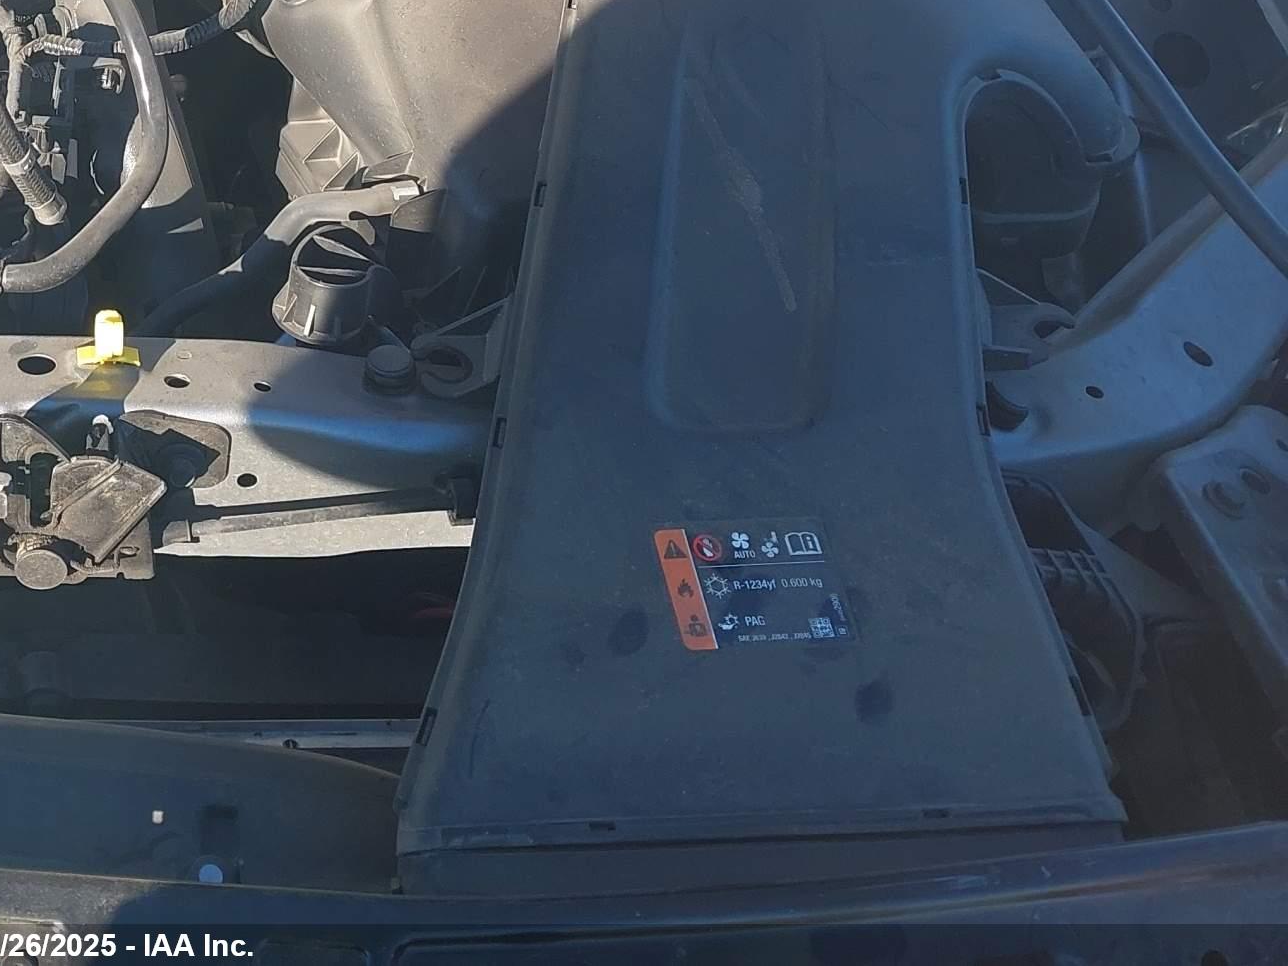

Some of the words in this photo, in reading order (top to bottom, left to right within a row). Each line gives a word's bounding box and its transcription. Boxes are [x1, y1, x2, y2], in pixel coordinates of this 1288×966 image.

[734, 550, 756, 559] AUTO
[733, 579, 777, 591] R-1234yf
[781, 579, 808, 588] 0.600
[809, 578, 823, 589] kg
[744, 615, 766, 626] PAG
